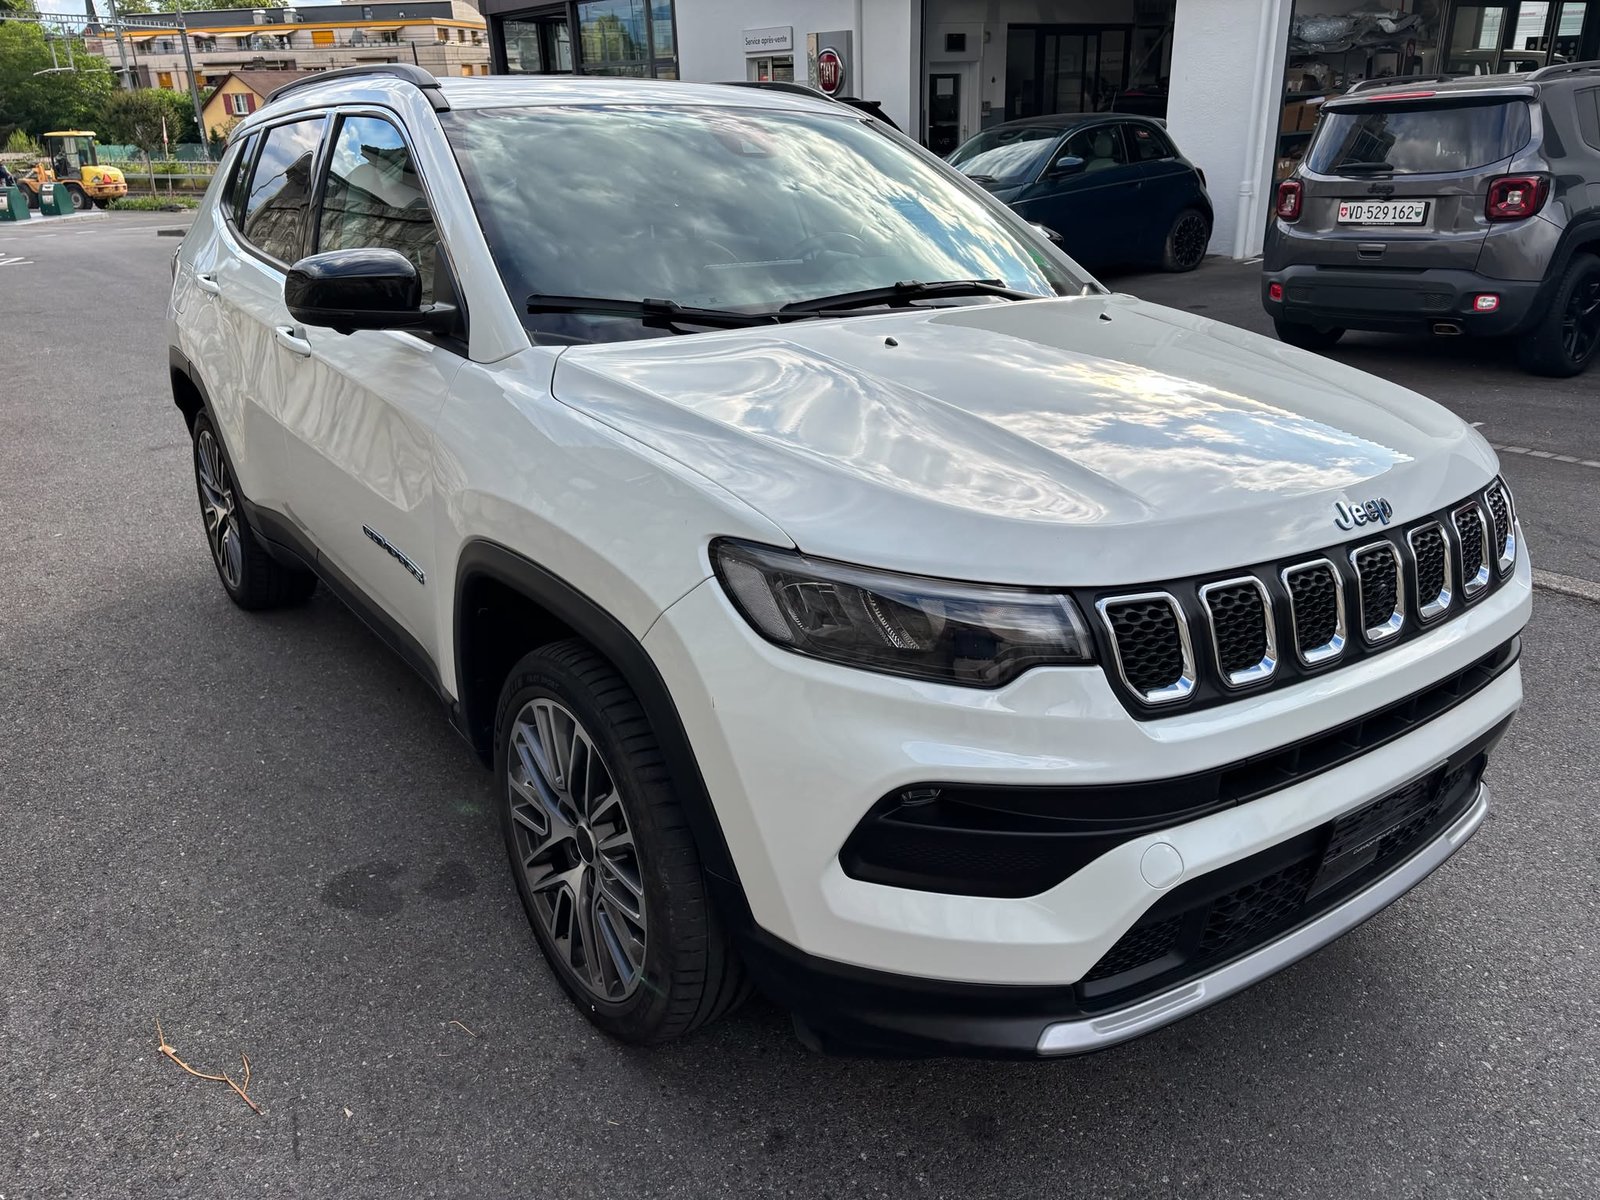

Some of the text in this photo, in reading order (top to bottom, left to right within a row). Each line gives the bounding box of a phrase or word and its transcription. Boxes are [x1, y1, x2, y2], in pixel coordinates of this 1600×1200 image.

[745, 35, 788, 46] Service après-vente
[820, 61, 836, 84] FIAT
[1334, 497, 1394, 531] Jeep
